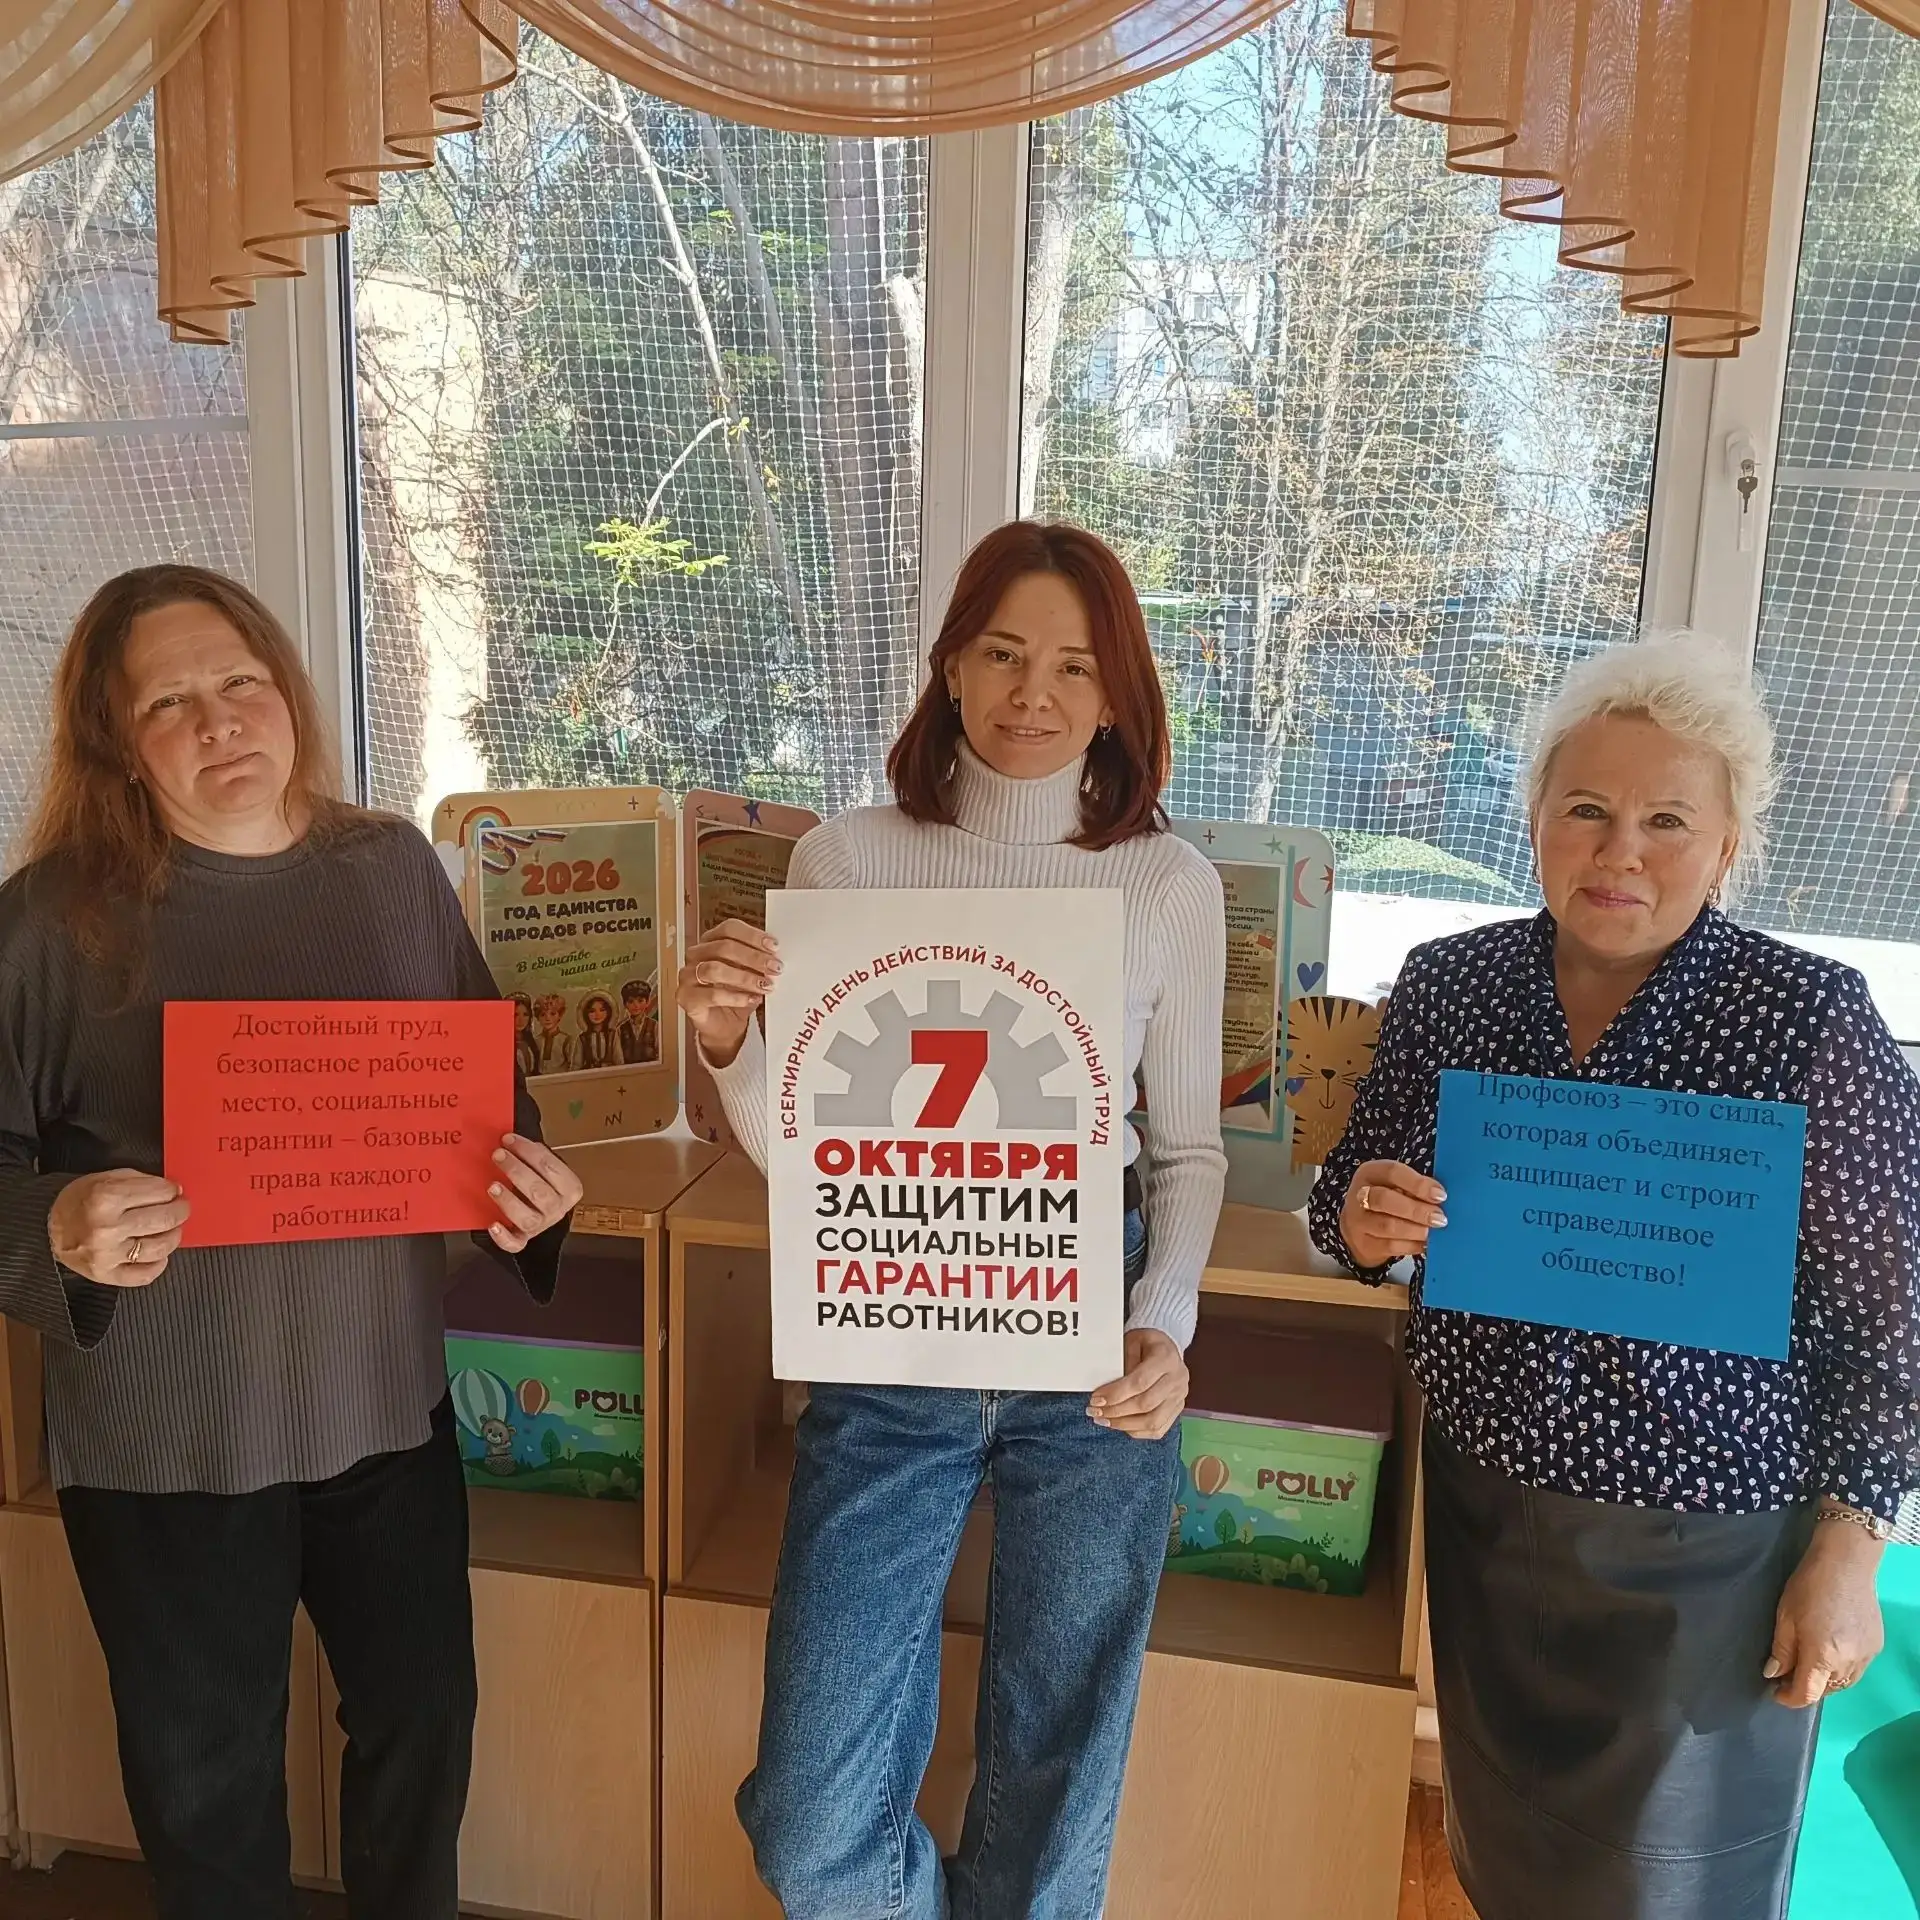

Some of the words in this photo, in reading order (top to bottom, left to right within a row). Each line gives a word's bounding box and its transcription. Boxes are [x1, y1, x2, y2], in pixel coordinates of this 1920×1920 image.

[521, 858, 620, 896] 2026
[504, 905, 540, 921] ГОД
[547, 898, 637, 917] ЕДИНСТВА
[490, 923, 577, 943] НАРОДОВ
[583, 917, 652, 935] РОССИИ
[516, 961, 528, 973] В
[561, 963, 597, 977] наша
[601, 952, 637, 969] сила!
[232, 1014, 379, 1038] Достойный
[387, 1018, 450, 1039] труд,
[780, 1007, 825, 1140] ВСЕМИРНЫЙ
[821, 969, 870, 1013] ДЕНЬ
[872, 944, 987, 978] ДЕЙСТВИЙ
[990, 955, 1017, 978] ЗА
[1017, 969, 1113, 1089] ДОСТОЙНЫЙ
[1090, 1092, 1111, 1146] ТРУД
[216, 1053, 360, 1075] безопасное
[368, 1053, 464, 1078] рабочее
[911, 1030, 988, 1128] 7
[221, 1095, 303, 1114] место,
[312, 1092, 459, 1112] социальные
[1477, 1075, 1620, 1110] Профсоюз
[1654, 1096, 1700, 1118] это
[1709, 1105, 1785, 1129] сила,
[218, 1133, 332, 1157] гарантии
[364, 1127, 462, 1148] базовые
[1482, 1120, 1588, 1150] которая
[1597, 1129, 1772, 1173] объединяет,
[814, 1138, 1078, 1181] ОКТЯБРЯ
[250, 1172, 321, 1195] права
[330, 1167, 432, 1187] каждого
[1489, 1161, 1625, 1193] защищает
[1634, 1179, 1650, 1196] и
[1660, 1182, 1760, 1210] строит
[271, 1201, 409, 1233] работника!
[815, 1182, 1078, 1226] ЗАЩИТИМ
[816, 1227, 1078, 1259] СОЦИАЛЬНЫЕ
[1522, 1208, 1714, 1247] справедливое
[816, 1259, 1078, 1303] ГАРАНТИИ
[1541, 1248, 1686, 1287] общество!
[817, 1302, 1079, 1336] РАБОТНИКОВ!
[574, 1388, 644, 1415] POLL
[1257, 1468, 1355, 1501] POLLY
